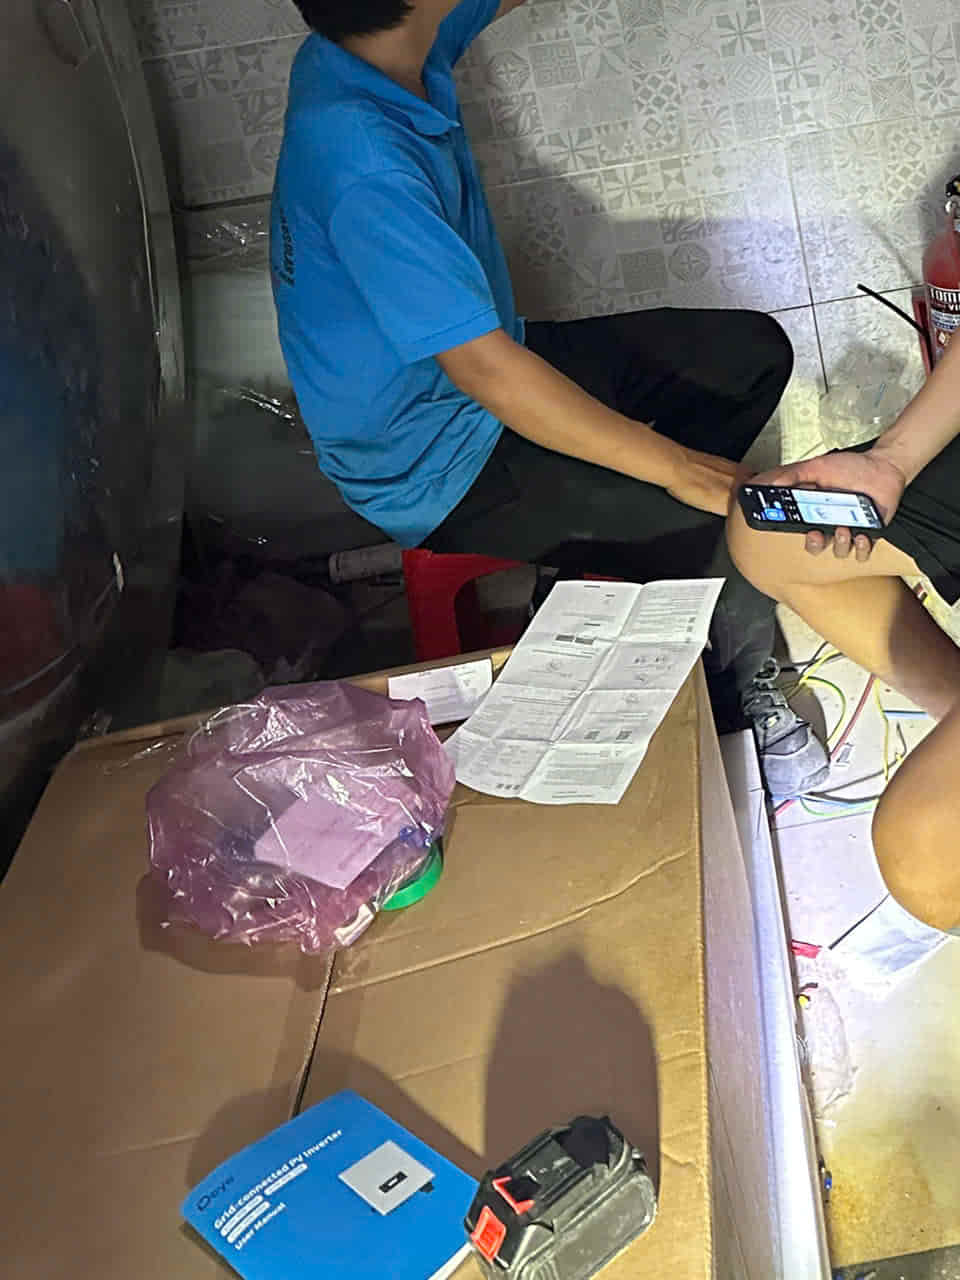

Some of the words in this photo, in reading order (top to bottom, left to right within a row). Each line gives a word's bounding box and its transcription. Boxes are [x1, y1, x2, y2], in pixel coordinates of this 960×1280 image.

[214, 1163, 290, 1229] Grid-connected
[288, 1154, 304, 1167] PV
[302, 1129, 342, 1158] Inverter
[235, 1229, 256, 1250] User
[254, 1202, 286, 1230] Manual
